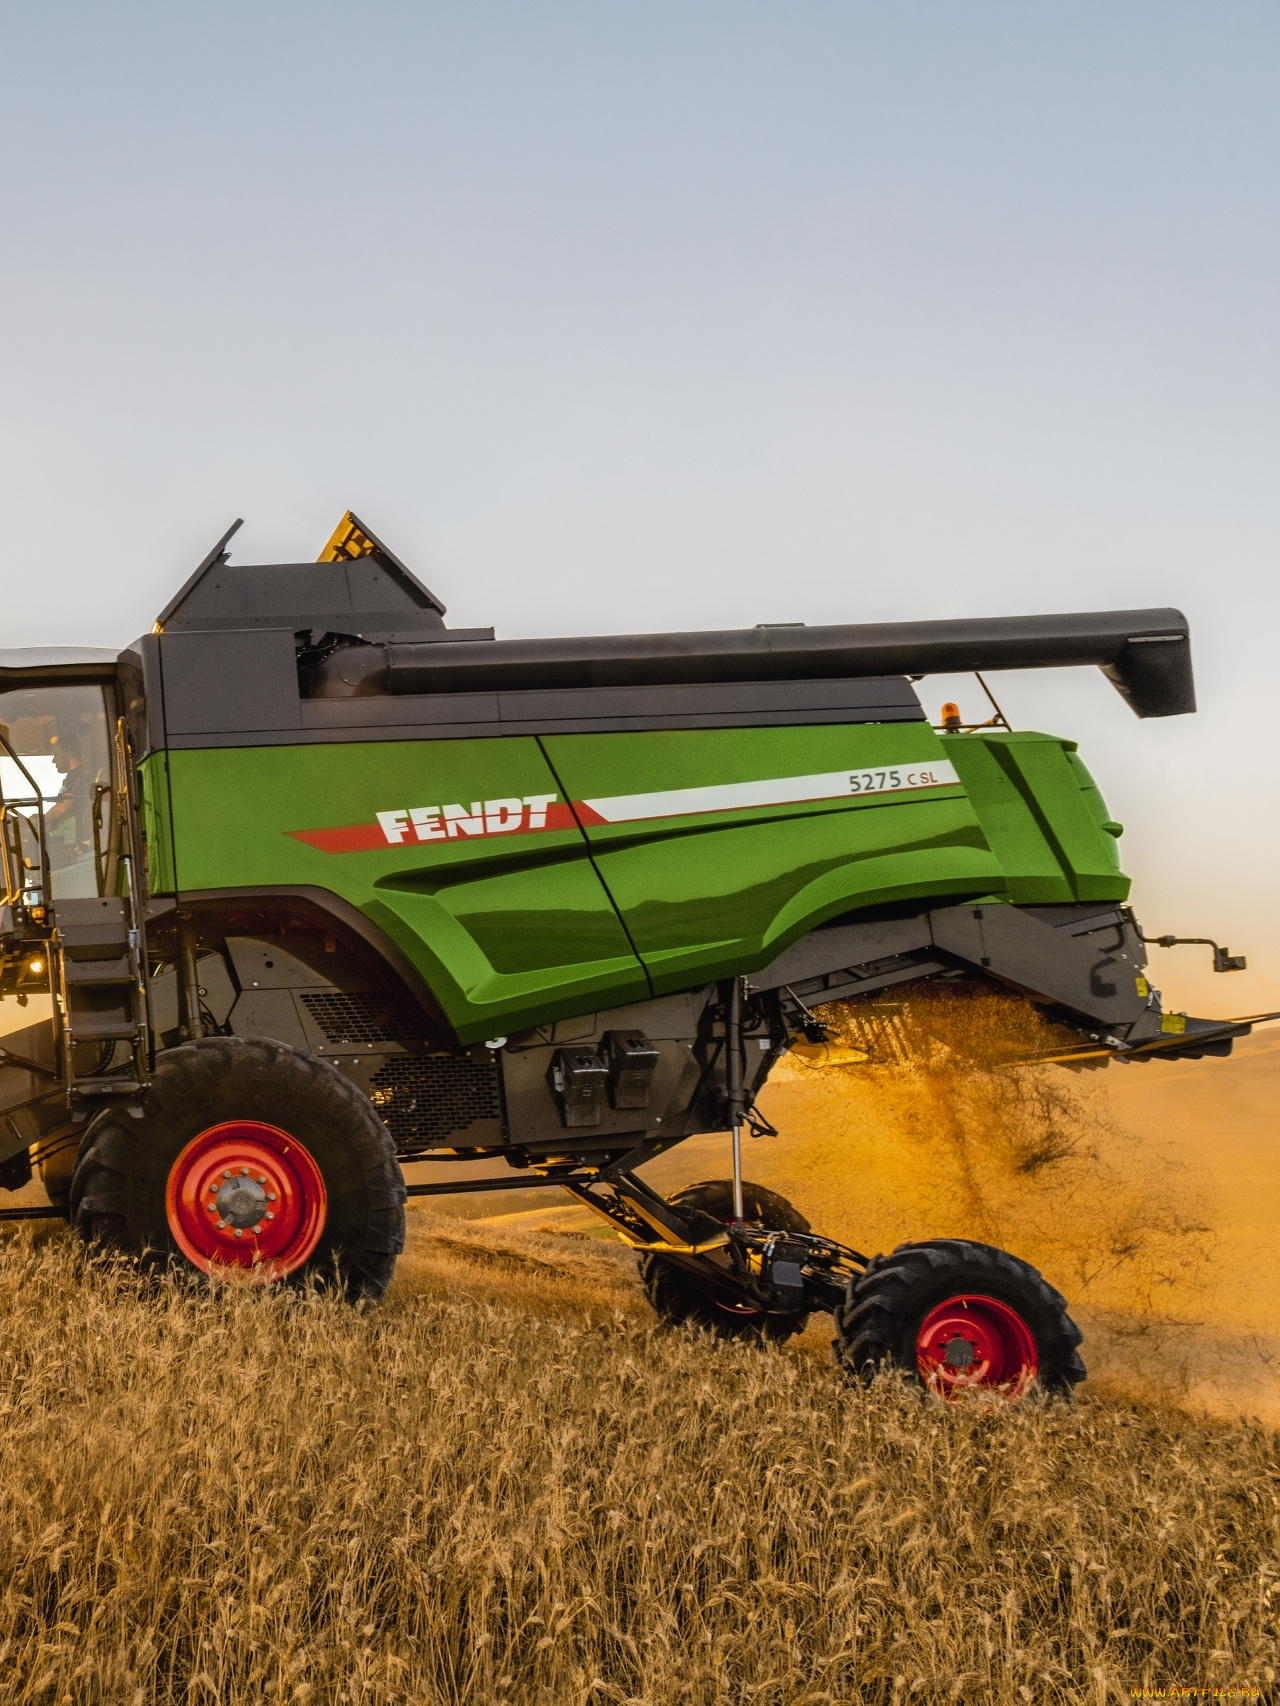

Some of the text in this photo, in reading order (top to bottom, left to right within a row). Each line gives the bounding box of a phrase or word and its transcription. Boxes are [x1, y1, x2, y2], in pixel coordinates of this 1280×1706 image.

[849, 771, 901, 792] 5275
[907, 773, 917, 785] C
[375, 793, 557, 844] FENDT
